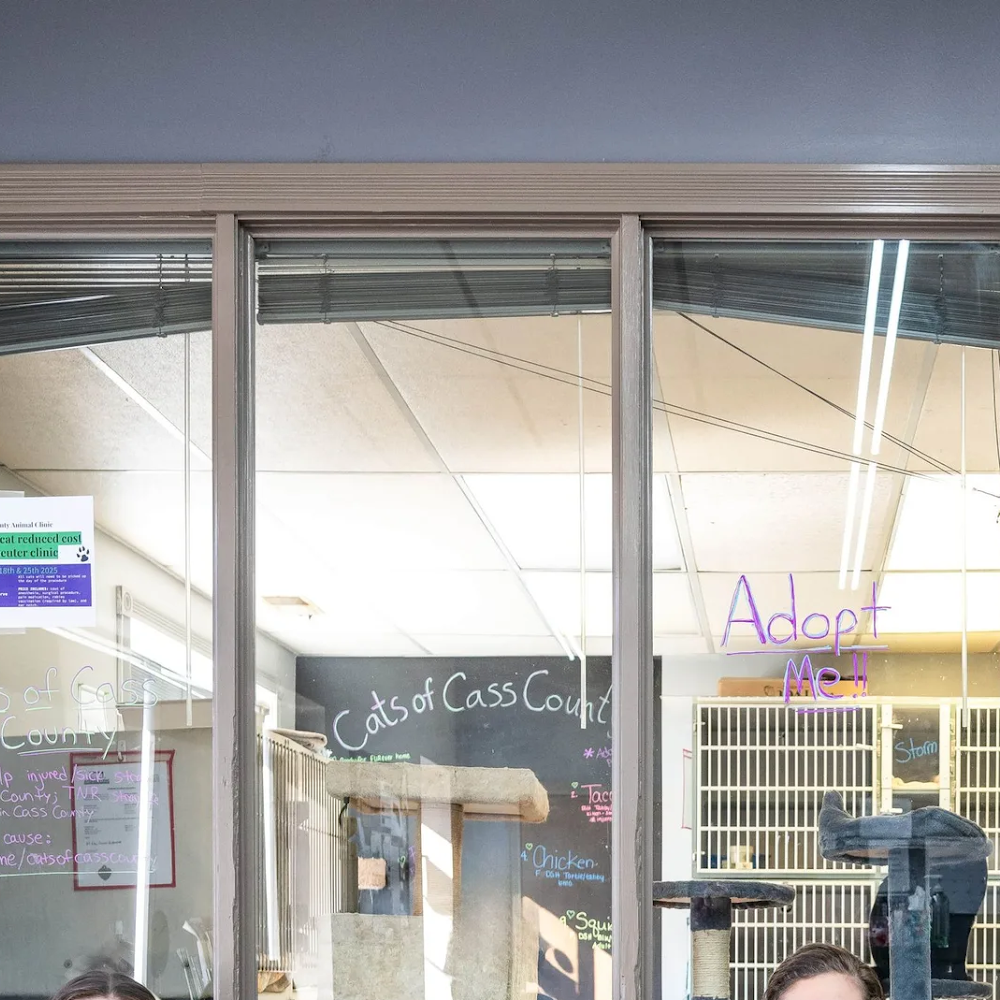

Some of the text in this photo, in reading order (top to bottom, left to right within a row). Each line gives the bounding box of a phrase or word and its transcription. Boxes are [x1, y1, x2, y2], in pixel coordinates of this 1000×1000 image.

[18, 533, 59, 544] reduced
[61, 533, 82, 543] cost
[30, 547, 59, 557] clinic
[720, 573, 891, 656] Adopt
[24, 667, 58, 704] of
[71, 665, 158, 706] Cass
[782, 652, 868, 703] Me!!
[334, 669, 612, 750] Cats of Cass Count
[1, 715, 117, 760] County
[894, 737, 938, 763] Storm
[62, 785, 102, 801] TNR
[13, 805, 48, 818] Cass
[52, 805, 95, 823] County
[3, 833, 51, 845] cause:
[532, 844, 598, 870] Chicken
